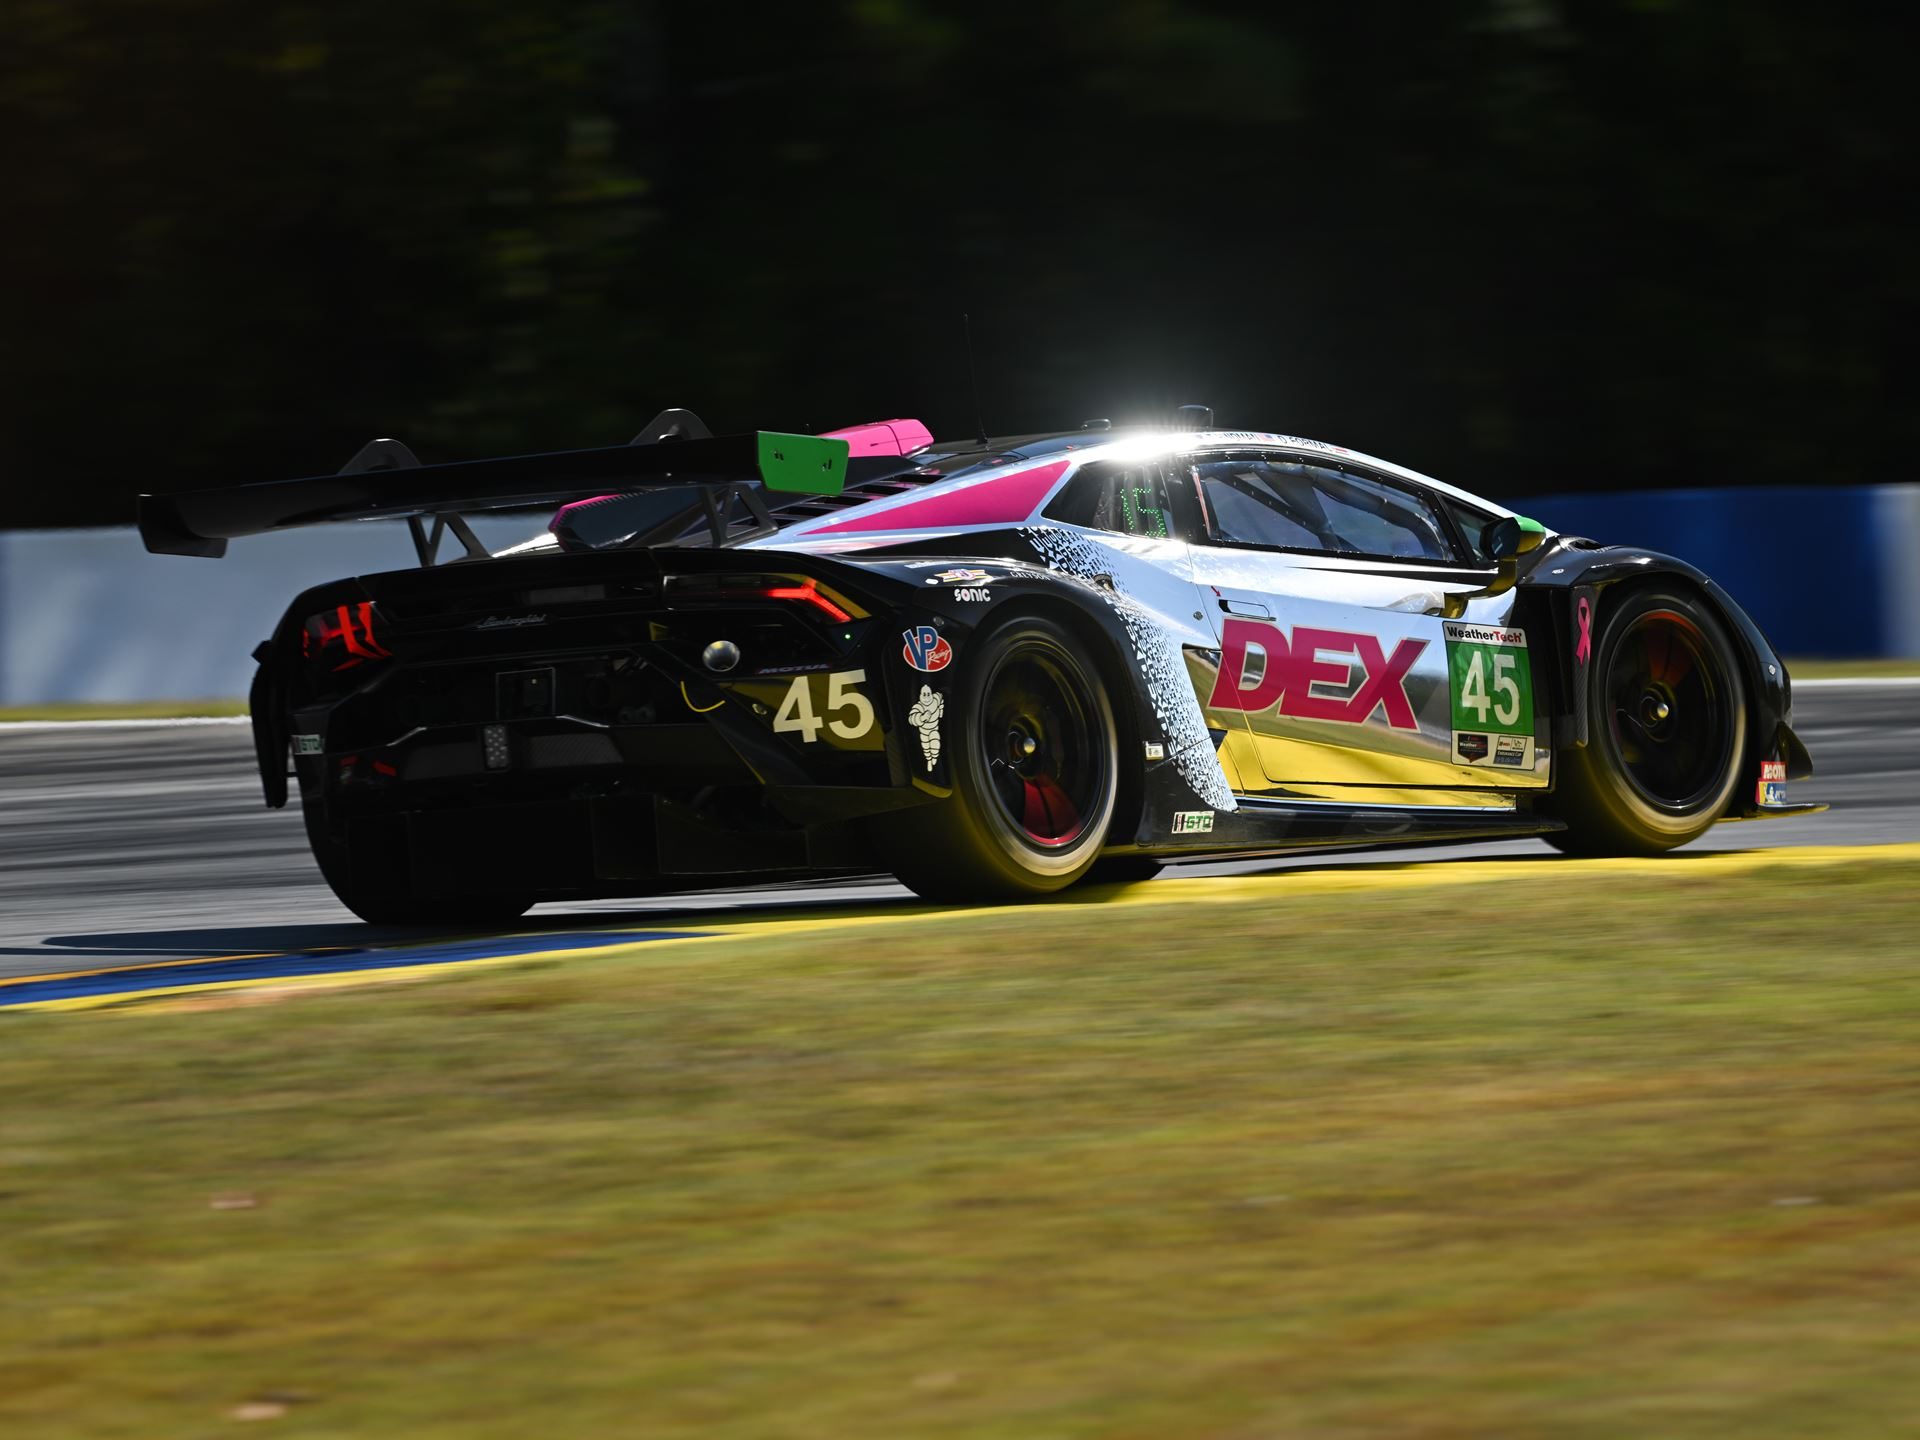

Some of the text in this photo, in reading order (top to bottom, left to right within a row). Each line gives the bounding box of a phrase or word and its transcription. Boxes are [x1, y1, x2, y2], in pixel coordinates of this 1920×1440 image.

[954, 588, 991, 602] SONIC
[902, 626, 939, 671] VP
[1447, 626, 1523, 643] WeatherTech
[1206, 615, 1431, 733] DEX
[1461, 650, 1520, 726] 45
[772, 668, 875, 743] 45
